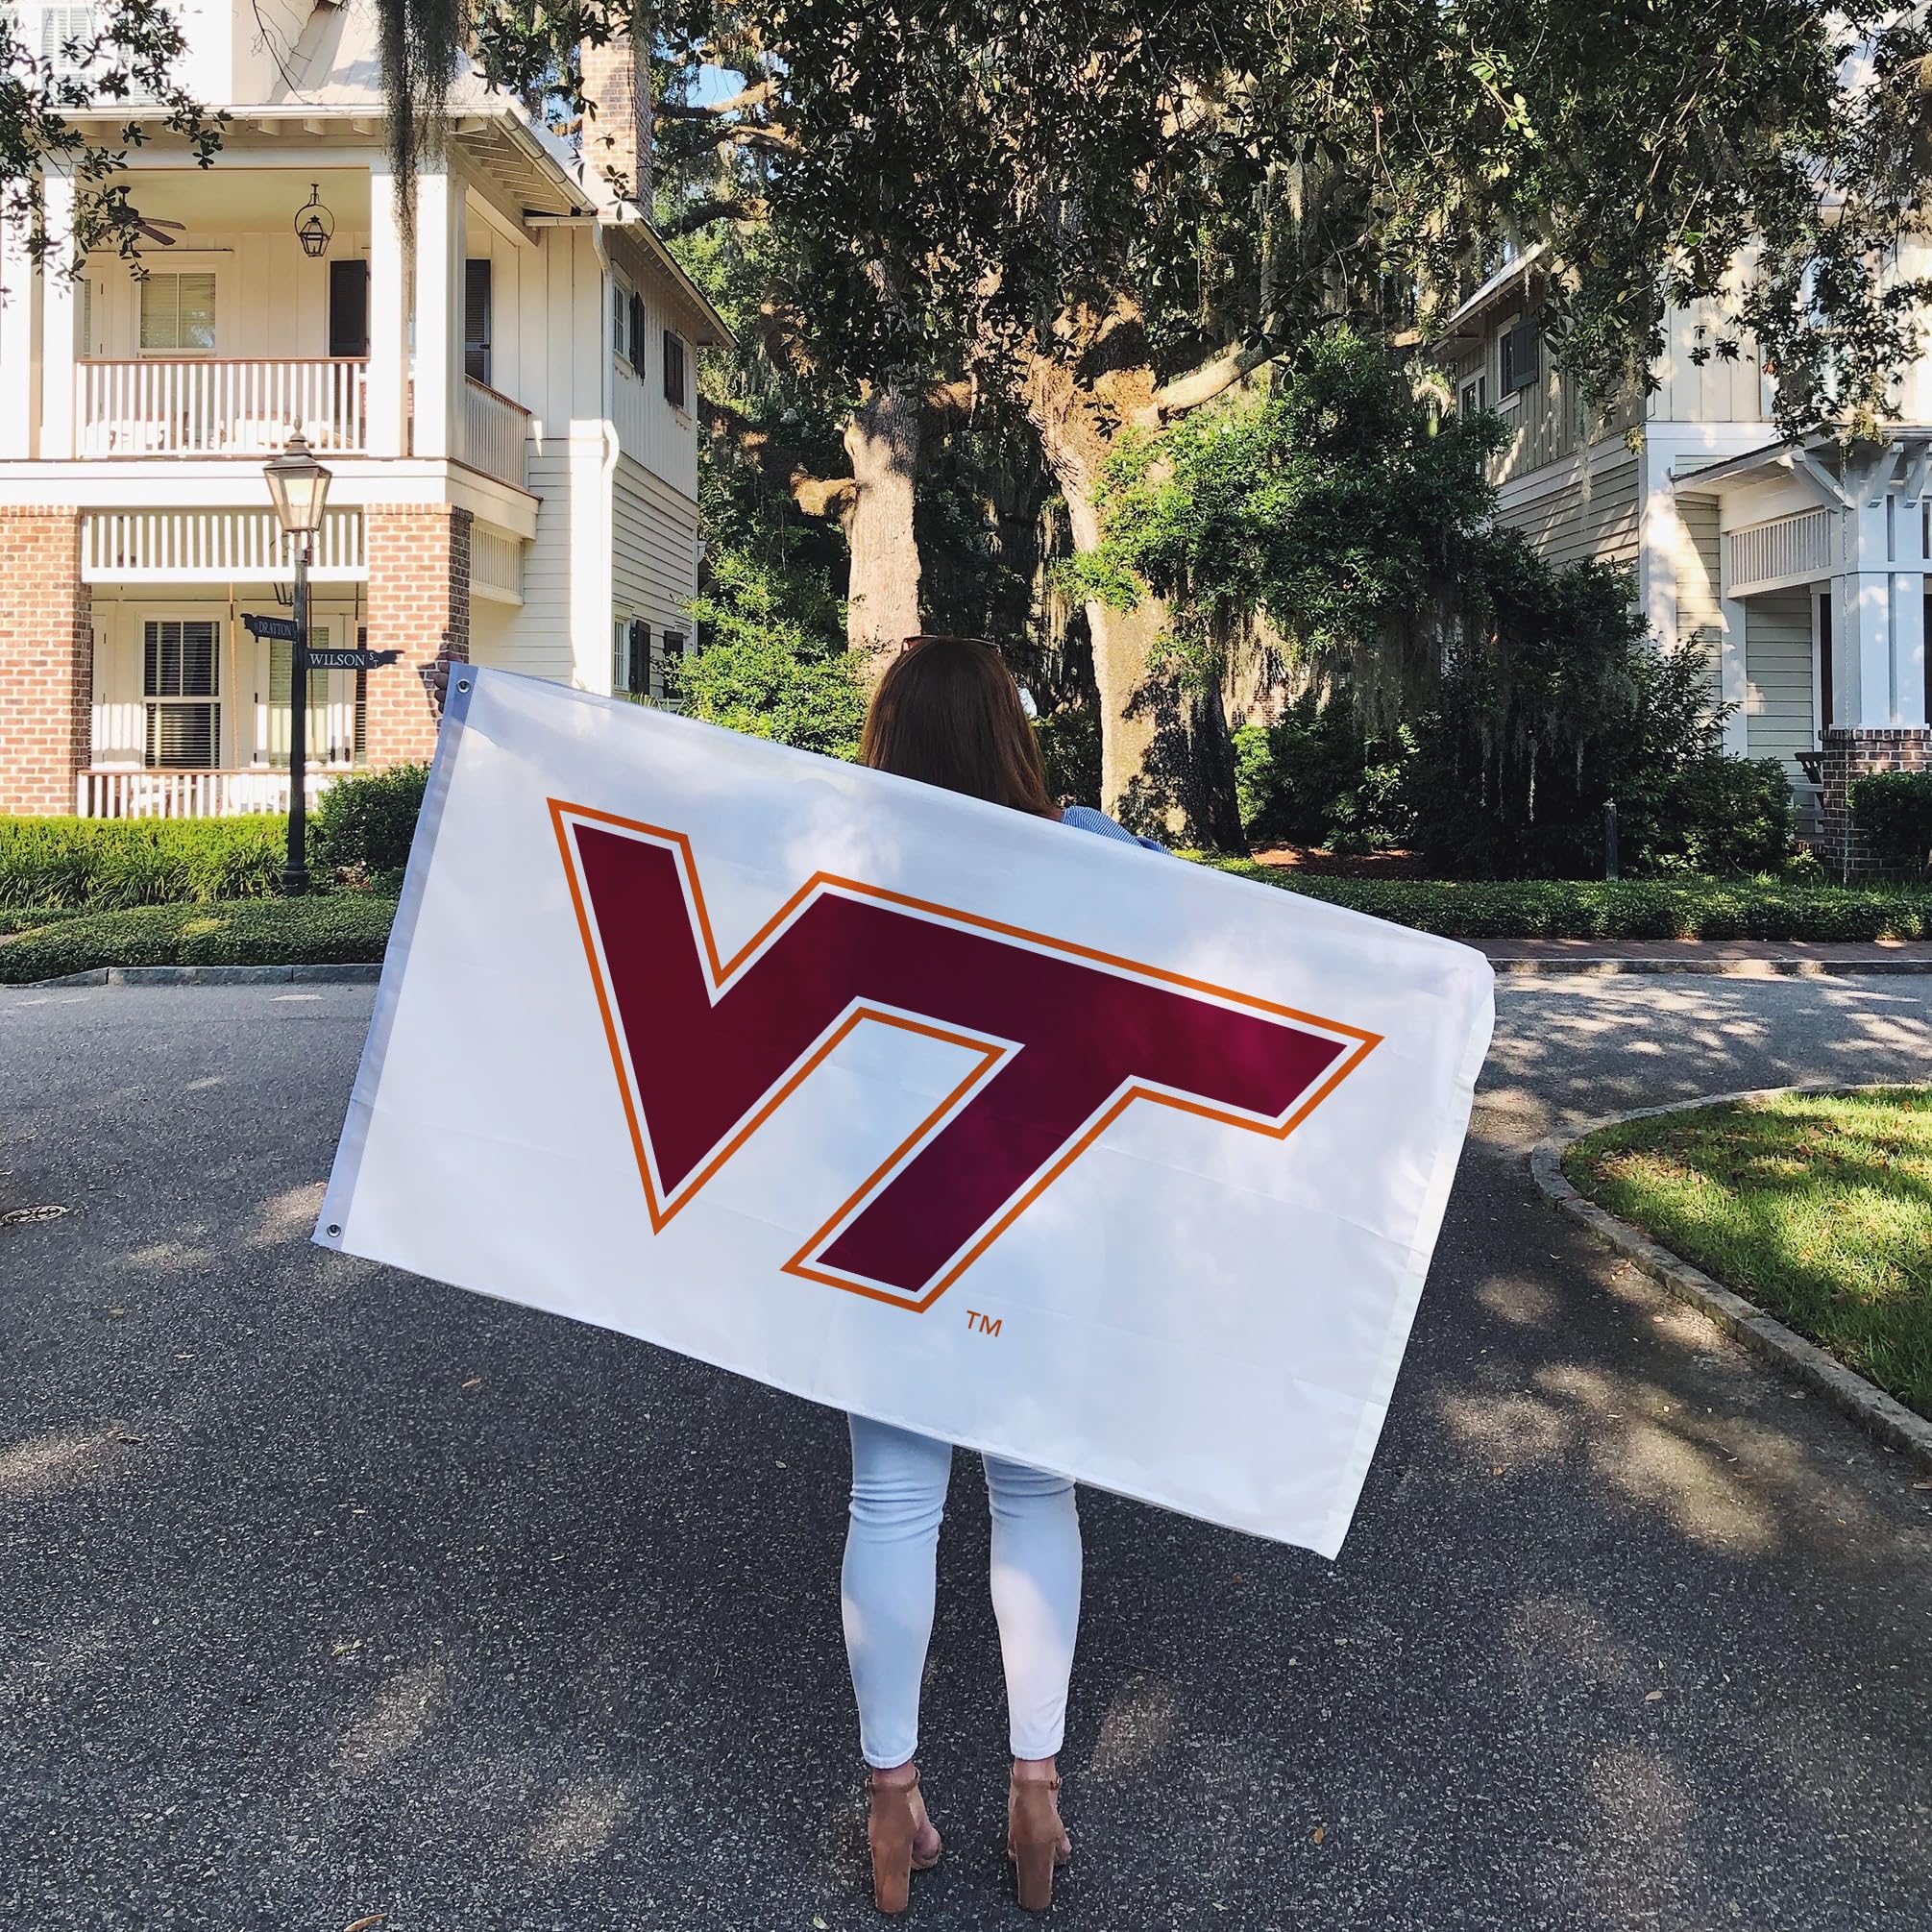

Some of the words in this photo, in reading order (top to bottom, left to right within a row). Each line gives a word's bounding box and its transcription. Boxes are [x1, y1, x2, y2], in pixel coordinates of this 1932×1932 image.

[309, 653, 365, 667] WILSON
[369, 651, 379, 669] ST
[548, 798, 1382, 1312] VT
[966, 1309, 1003, 1338] TM
